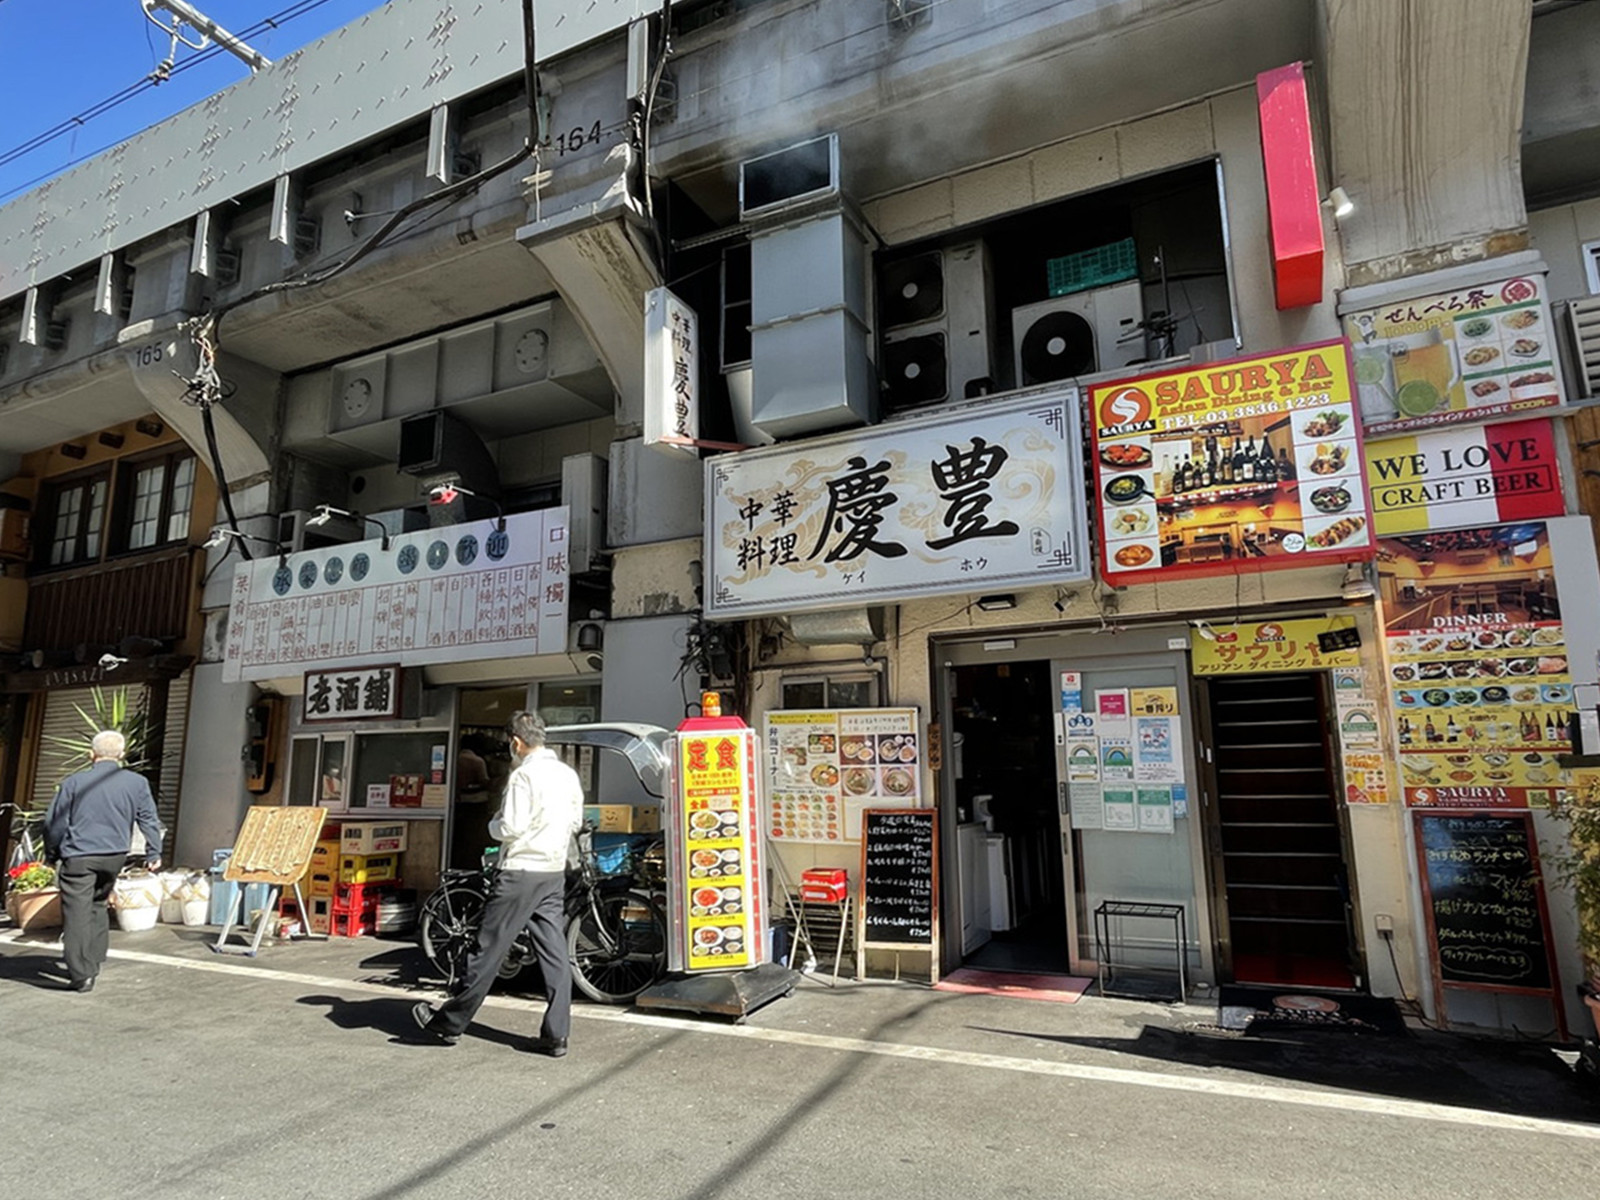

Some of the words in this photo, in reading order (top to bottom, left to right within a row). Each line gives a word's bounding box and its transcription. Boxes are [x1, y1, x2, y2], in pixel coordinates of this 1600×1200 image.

[556, 120, 601, 157] 164
[1384, 289, 1494, 324] せんべろ祭
[136, 341, 162, 367] 165
[1155, 353, 1333, 406] SAURYA
[1158, 401, 1207, 418] Asian
[1211, 391, 1274, 409] Dining
[1279, 384, 1294, 397] &
[1297, 379, 1334, 393] Bar
[1100, 420, 1153, 437] SAURYA
[1372, 453, 1429, 481] WE
[1442, 437, 1540, 472] LOVE
[807, 436, 1020, 565] 慶豊
[1381, 481, 1465, 507] CRAFT
[1476, 472, 1543, 496] BEER
[738, 489, 799, 532] 中華
[736, 532, 800, 571] 料理
[960, 557, 988, 572] ホウ
[842, 571, 867, 584] ケイ
[1432, 612, 1508, 628] DINNER
[1199, 662, 1244, 673] アジアン
[1249, 658, 1306, 671] ダイニング
[1327, 656, 1353, 665] バー
[1135, 701, 1174, 715] 一番搾り
[687, 737, 738, 773] 定食
[769, 726, 780, 786] 弁当コーナー
[1436, 787, 1507, 798] SAURYA
